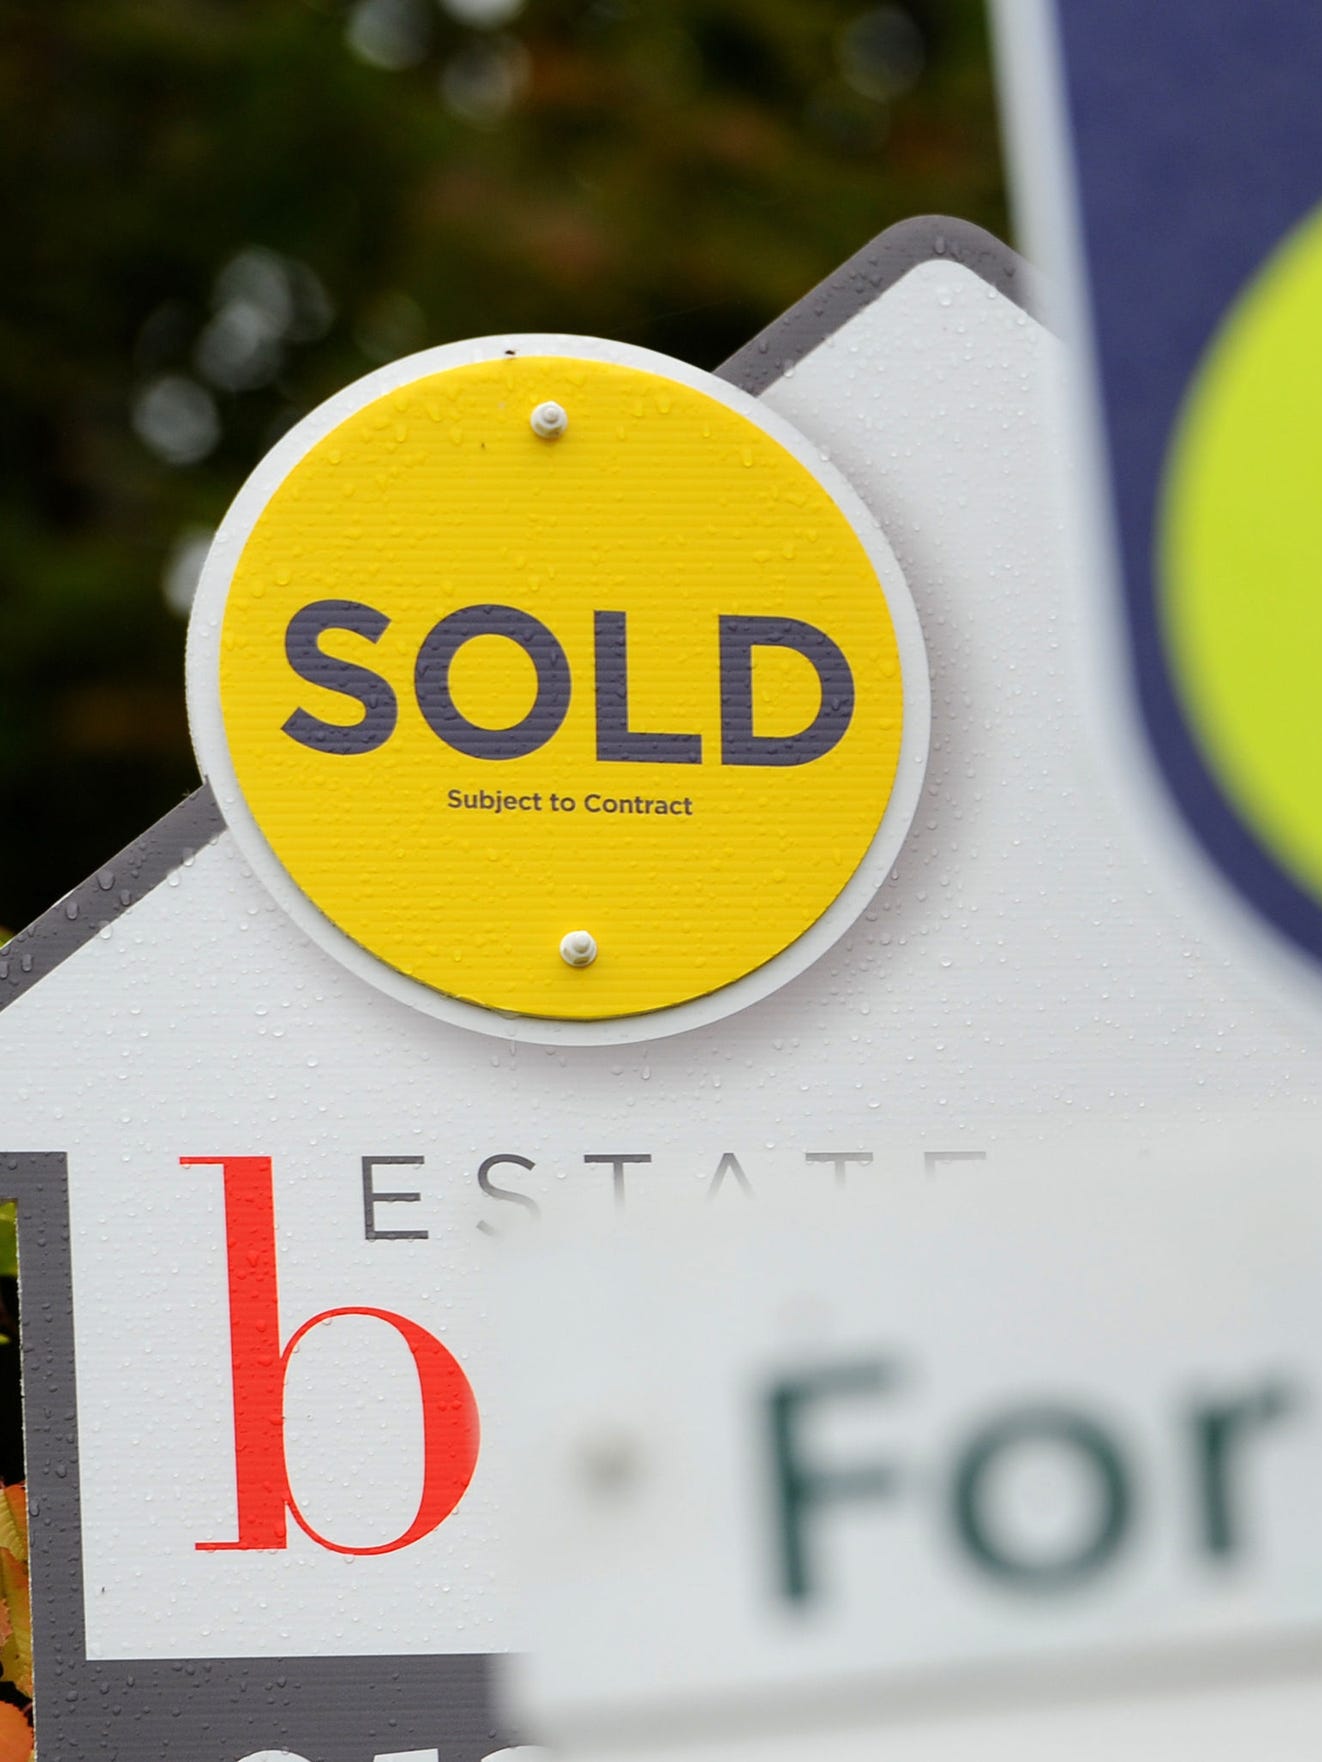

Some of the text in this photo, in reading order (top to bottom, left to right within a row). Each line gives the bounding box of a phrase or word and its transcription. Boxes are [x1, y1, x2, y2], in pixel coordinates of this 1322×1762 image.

[280, 598, 855, 766] SOLD
[448, 789, 693, 815] Subject to Contract
[180, 1156, 481, 1555] b
[755, 1345, 1300, 1615] For
